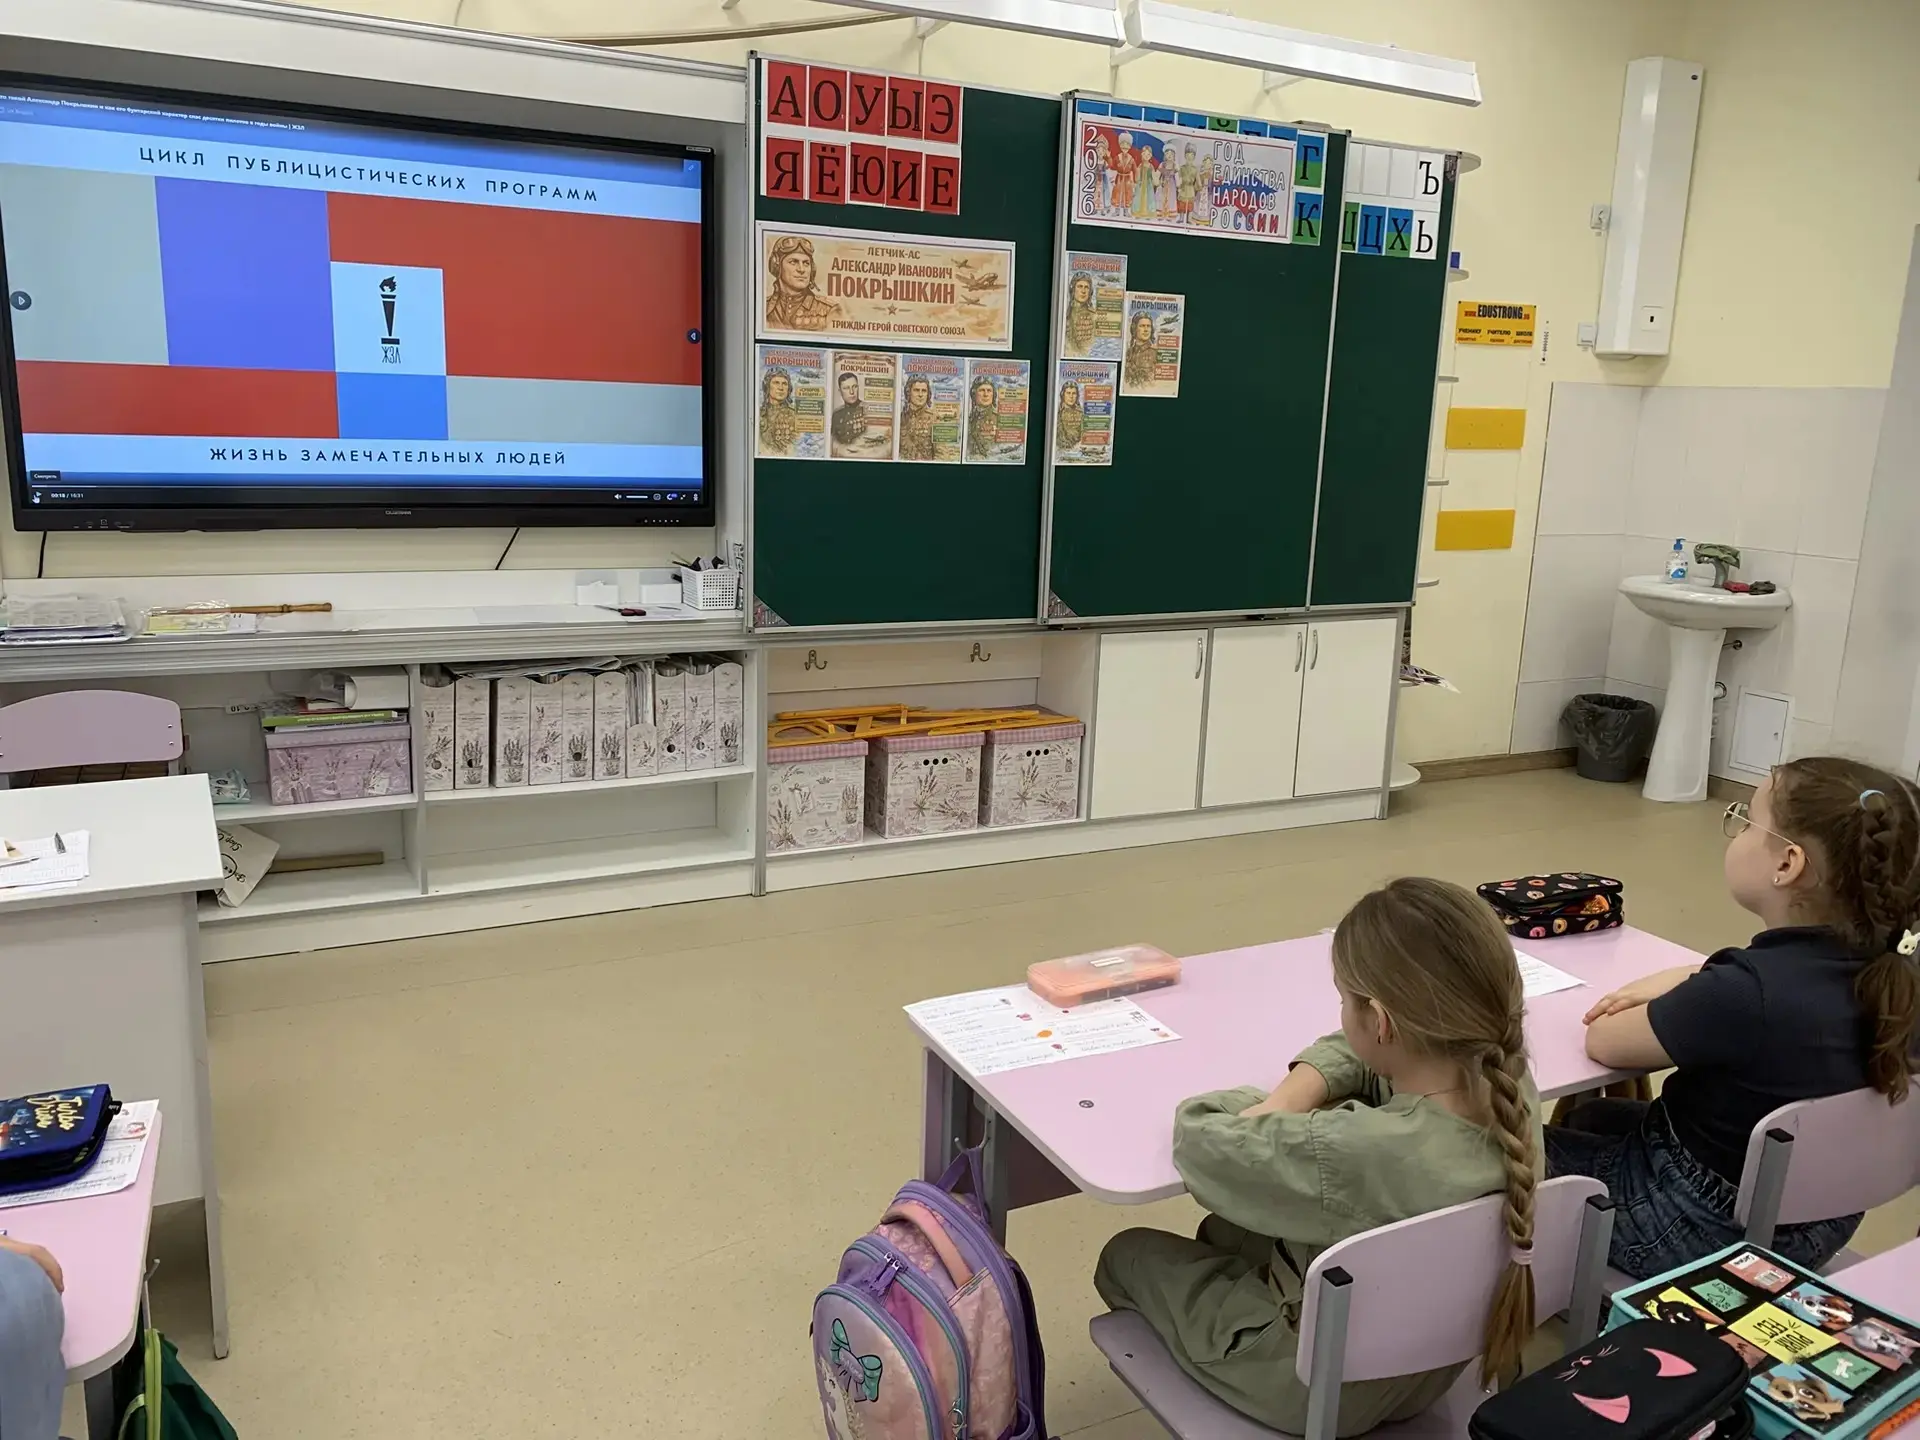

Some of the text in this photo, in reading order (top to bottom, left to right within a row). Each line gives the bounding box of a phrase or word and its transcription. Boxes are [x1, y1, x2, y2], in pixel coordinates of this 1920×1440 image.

[770, 75, 954, 135] А О У Ы Э
[1213, 141, 1244, 165] ГОД
[1300, 145, 1320, 180] Г
[139, 147, 598, 202] ЦИКЛ ПУБЛИЦИСТИЧЕСКИХ ПРОГРАММ
[770, 146, 954, 207] Я Ё Ю И Е
[1212, 164, 1286, 191] ЕДИНСТВА
[1419, 161, 1440, 195] Ъ
[1212, 187, 1276, 212] НАРОДОВ
[1209, 208, 1279, 234] РОССИИ
[1295, 202, 1320, 238] К
[1415, 220, 1433, 253] Ь
[867, 247, 921, 260] ЛЕТЧИК-АС
[831, 257, 953, 279] АЛЕКСАНДР ИВАНОВИЧ
[827, 273, 955, 305] ПОКРЫШКИН
[1131, 301, 1179, 313] ПОКРЫШКИН
[832, 319, 966, 336] ТРИЖДЫ ГЕРОЙ СОВЕТСКОГО СОЮЗА
[381, 346, 402, 364] ЖЗЛ
[764, 356, 821, 370] ПОКРЫШКИН
[840, 364, 889, 374] ПОКРЫШКИН
[1062, 370, 1110, 379] ПОКРЫШКИН
[210, 448, 566, 465] ЖИЗНЬ ЗАМЕЧАТЕЛЬНЫХ ЛЮДЕЙ
[1753, 1317, 1788, 1339] FECT
[1774, 1330, 1814, 1353] PURR
